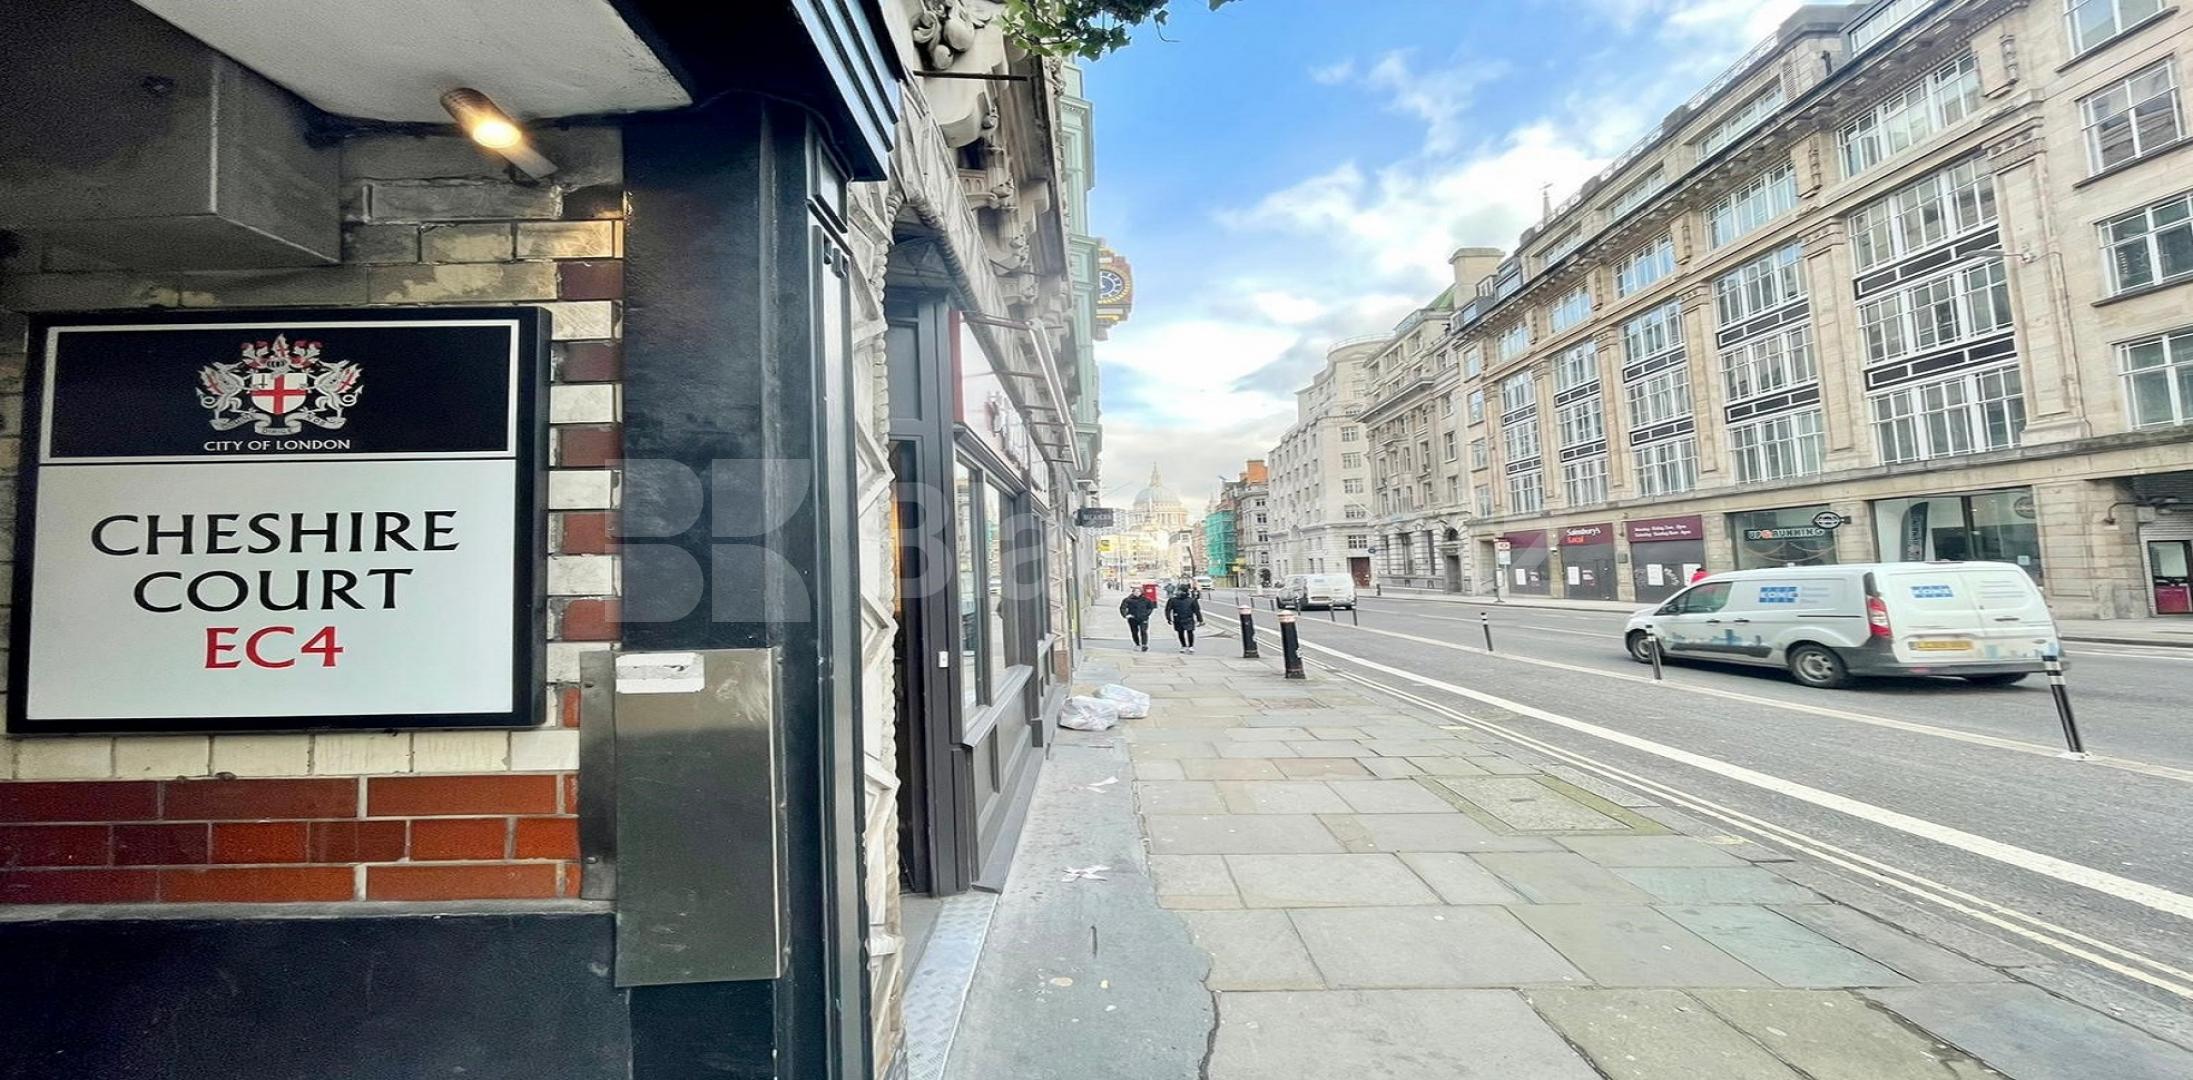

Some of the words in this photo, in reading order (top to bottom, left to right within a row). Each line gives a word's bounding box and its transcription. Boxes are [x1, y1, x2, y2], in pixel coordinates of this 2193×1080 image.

[203, 440, 244, 452] CITY
[247, 440, 271, 451] OF
[276, 439, 351, 451] LONDON
[91, 510, 459, 556] CHESHIRE
[1566, 527, 1601, 537] Sainsbury's
[133, 568, 414, 613] COURT
[204, 625, 344, 669] EC4
